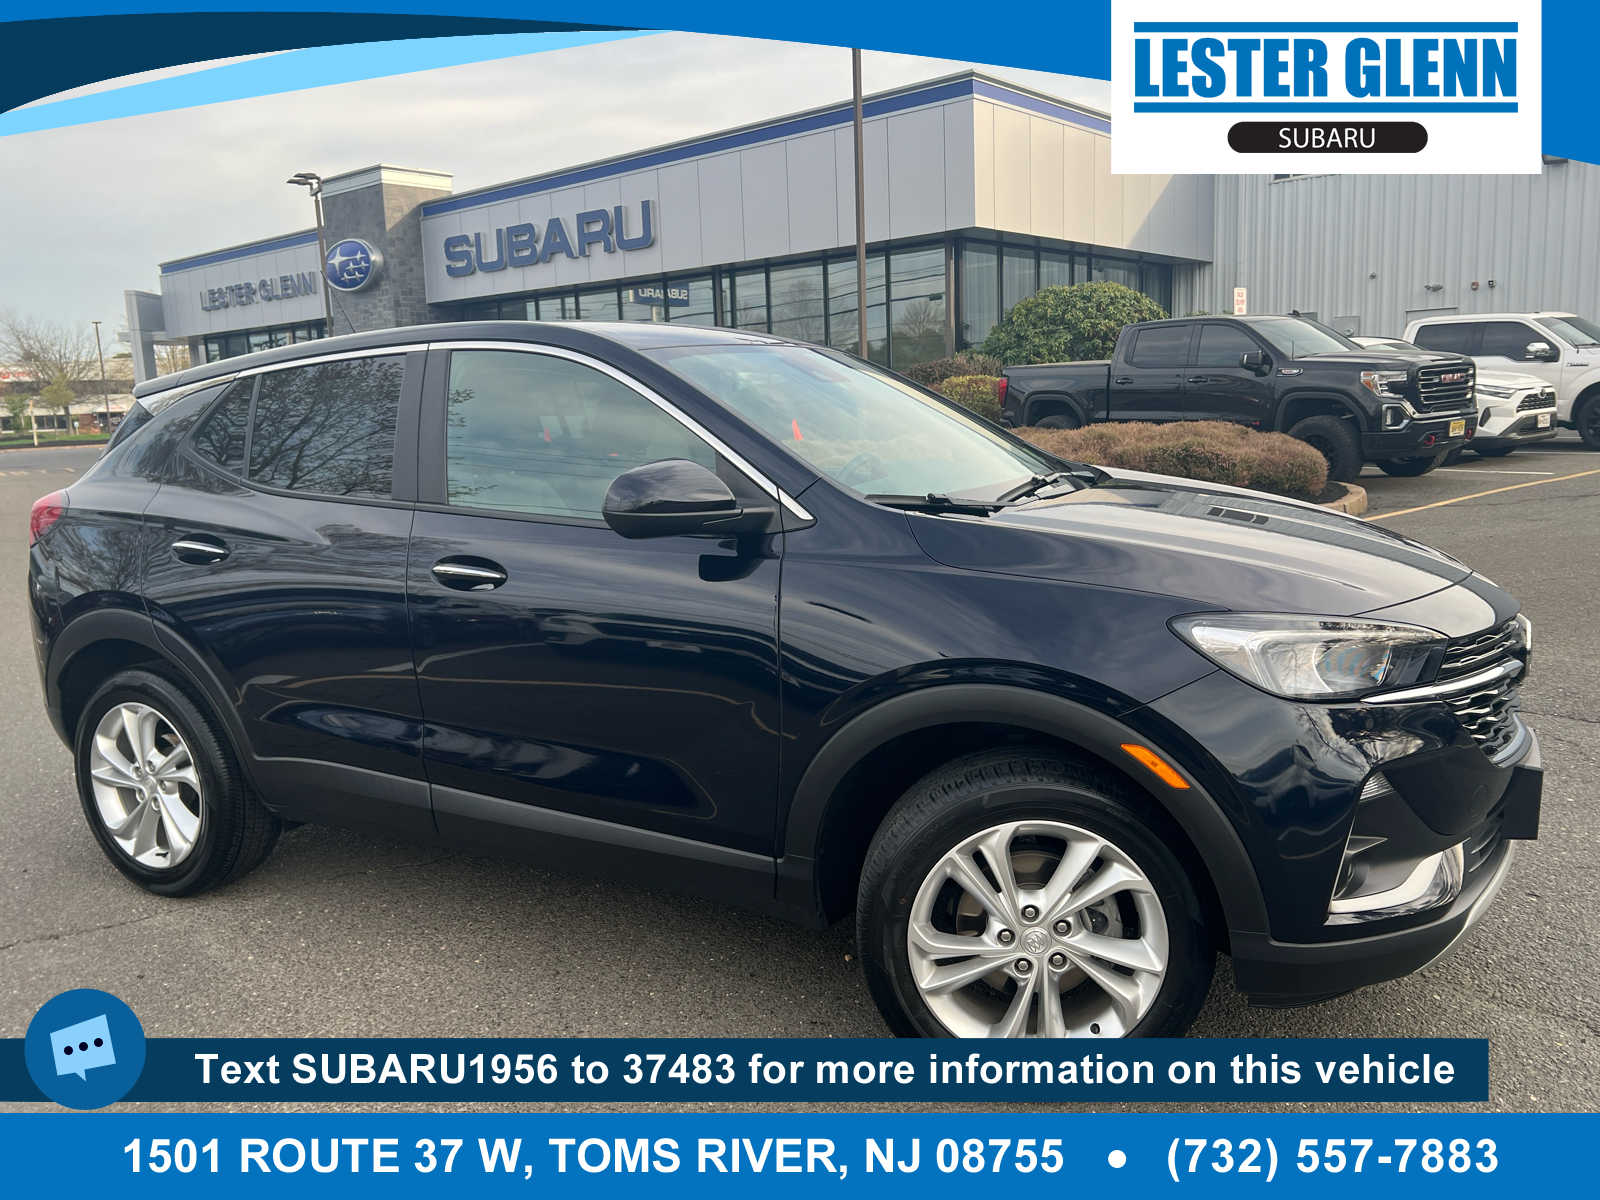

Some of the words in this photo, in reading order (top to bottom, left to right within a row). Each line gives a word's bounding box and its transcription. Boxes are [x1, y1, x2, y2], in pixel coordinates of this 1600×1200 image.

[444, 200, 653, 277] SUBARU
[200, 282, 258, 311] LESTER
[259, 272, 318, 302] GLENN
